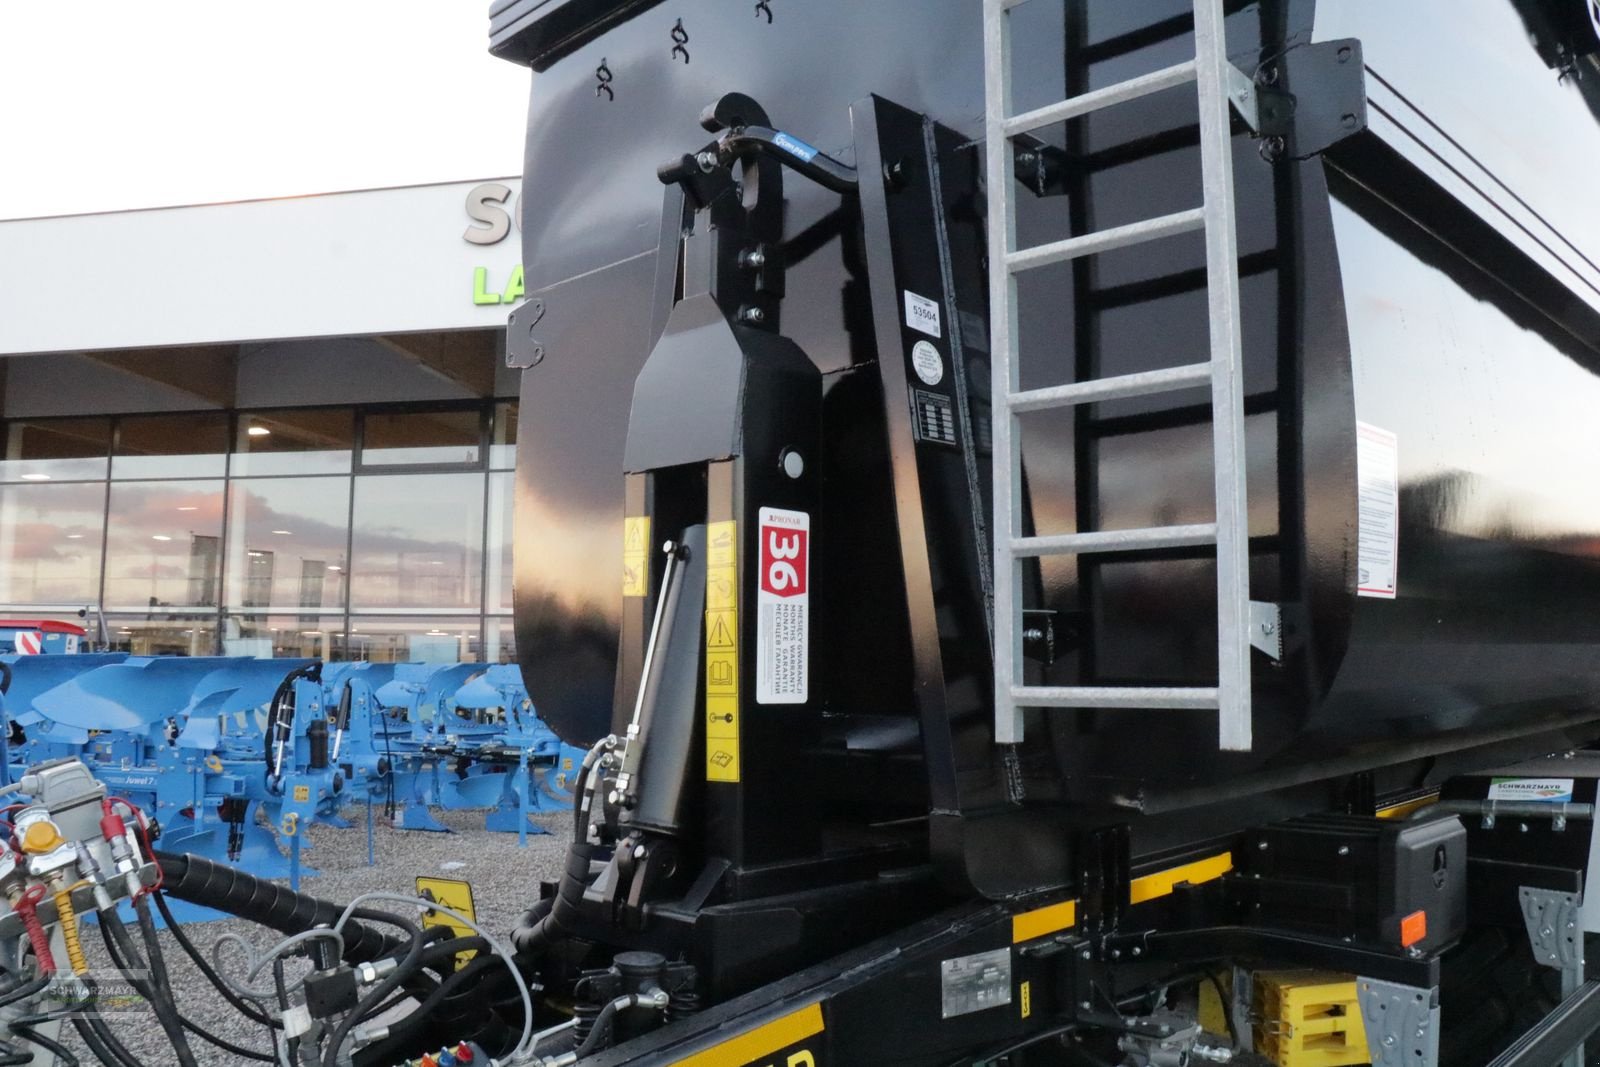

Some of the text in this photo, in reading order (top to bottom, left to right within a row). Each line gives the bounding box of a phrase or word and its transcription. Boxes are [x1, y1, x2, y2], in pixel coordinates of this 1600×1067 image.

[462, 183, 522, 246] S
[913, 305, 937, 322] 53504
[769, 530, 800, 591] 36
